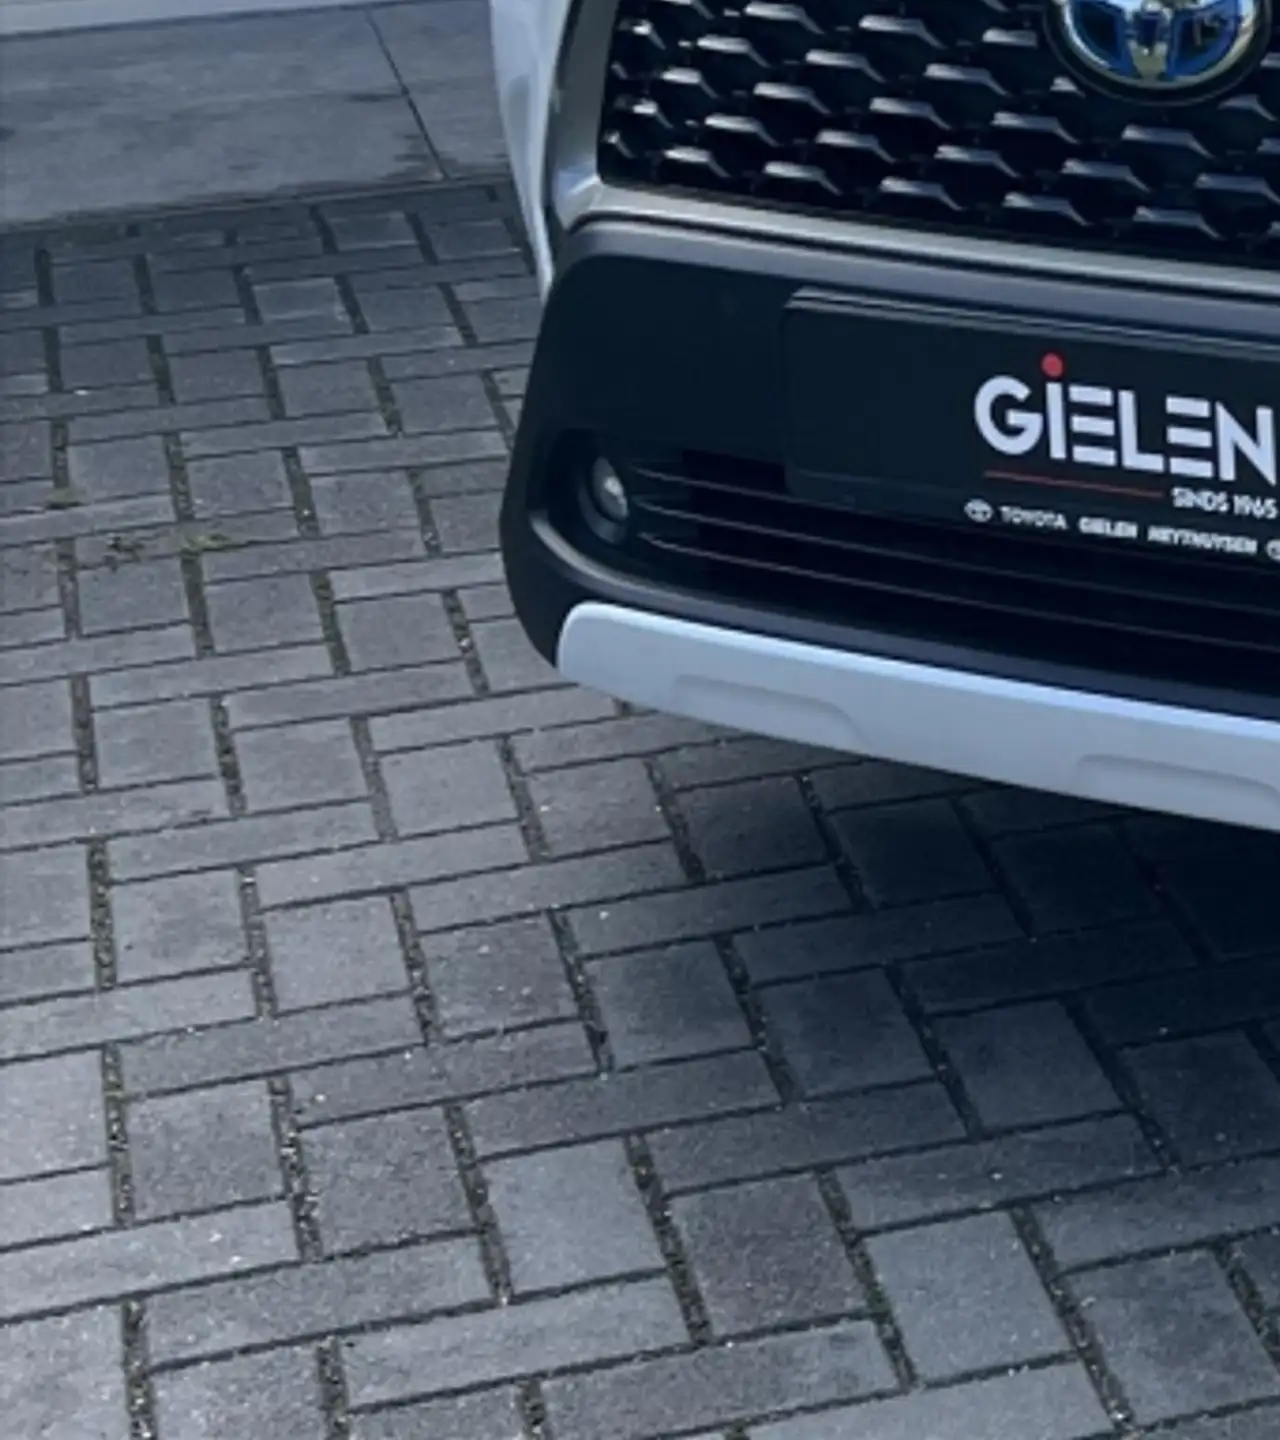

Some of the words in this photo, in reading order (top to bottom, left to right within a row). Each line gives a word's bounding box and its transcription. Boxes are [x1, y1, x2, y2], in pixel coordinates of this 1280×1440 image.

[974, 353, 1277, 487] GIELEN
[1171, 487, 1229, 513] SINDS
[1233, 493, 1279, 520] 1965
[998, 505, 1068, 531] TOYOTA
[1078, 516, 1138, 539] GIELEN
